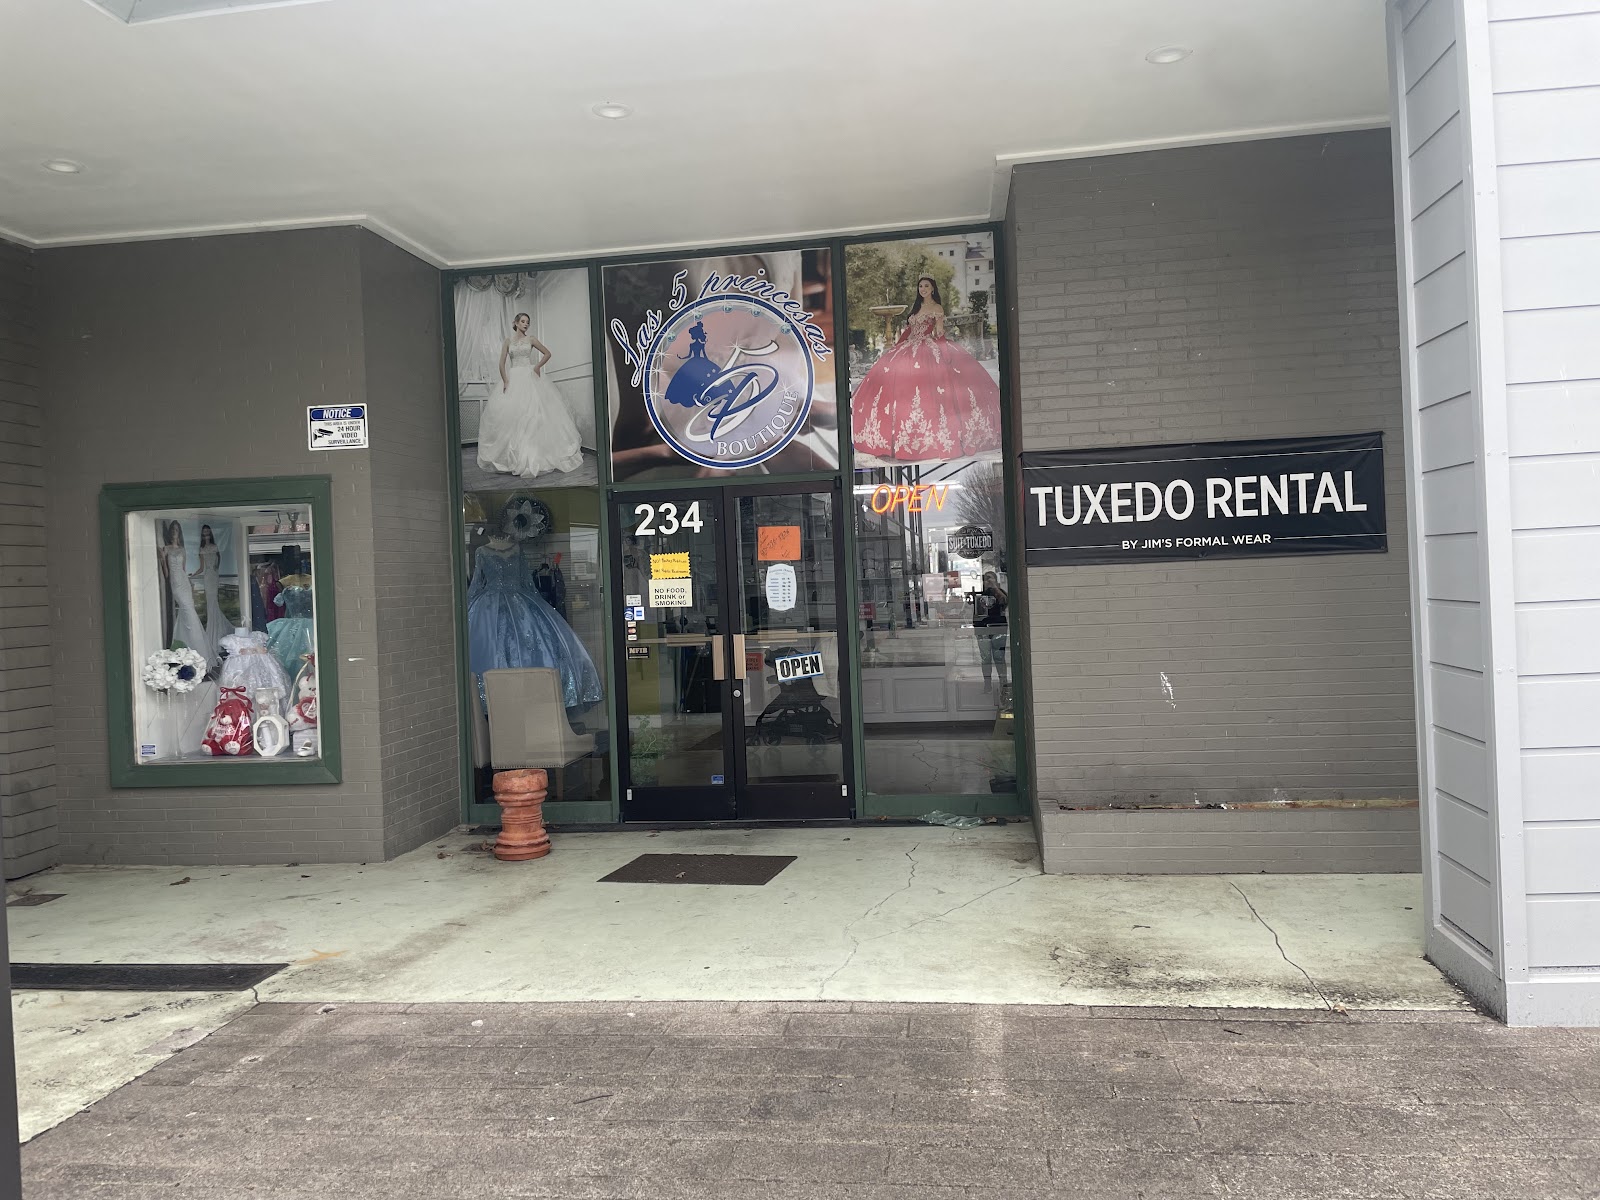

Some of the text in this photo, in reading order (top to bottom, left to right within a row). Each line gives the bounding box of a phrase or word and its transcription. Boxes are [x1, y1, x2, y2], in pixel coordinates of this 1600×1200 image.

[610, 268, 832, 387] Las 5 princesas
[323, 408, 352, 419] NOTICE
[716, 390, 799, 457] BOUTIQUE
[871, 484, 949, 514] OPEN
[1030, 470, 1367, 527] TUXEDO RENTAL
[634, 501, 704, 536] 234
[966, 535, 992, 549] TUXEDO
[1121, 534, 1271, 550] BY JIM'S FORMAL WEAR
[779, 655, 821, 678] OPEN
